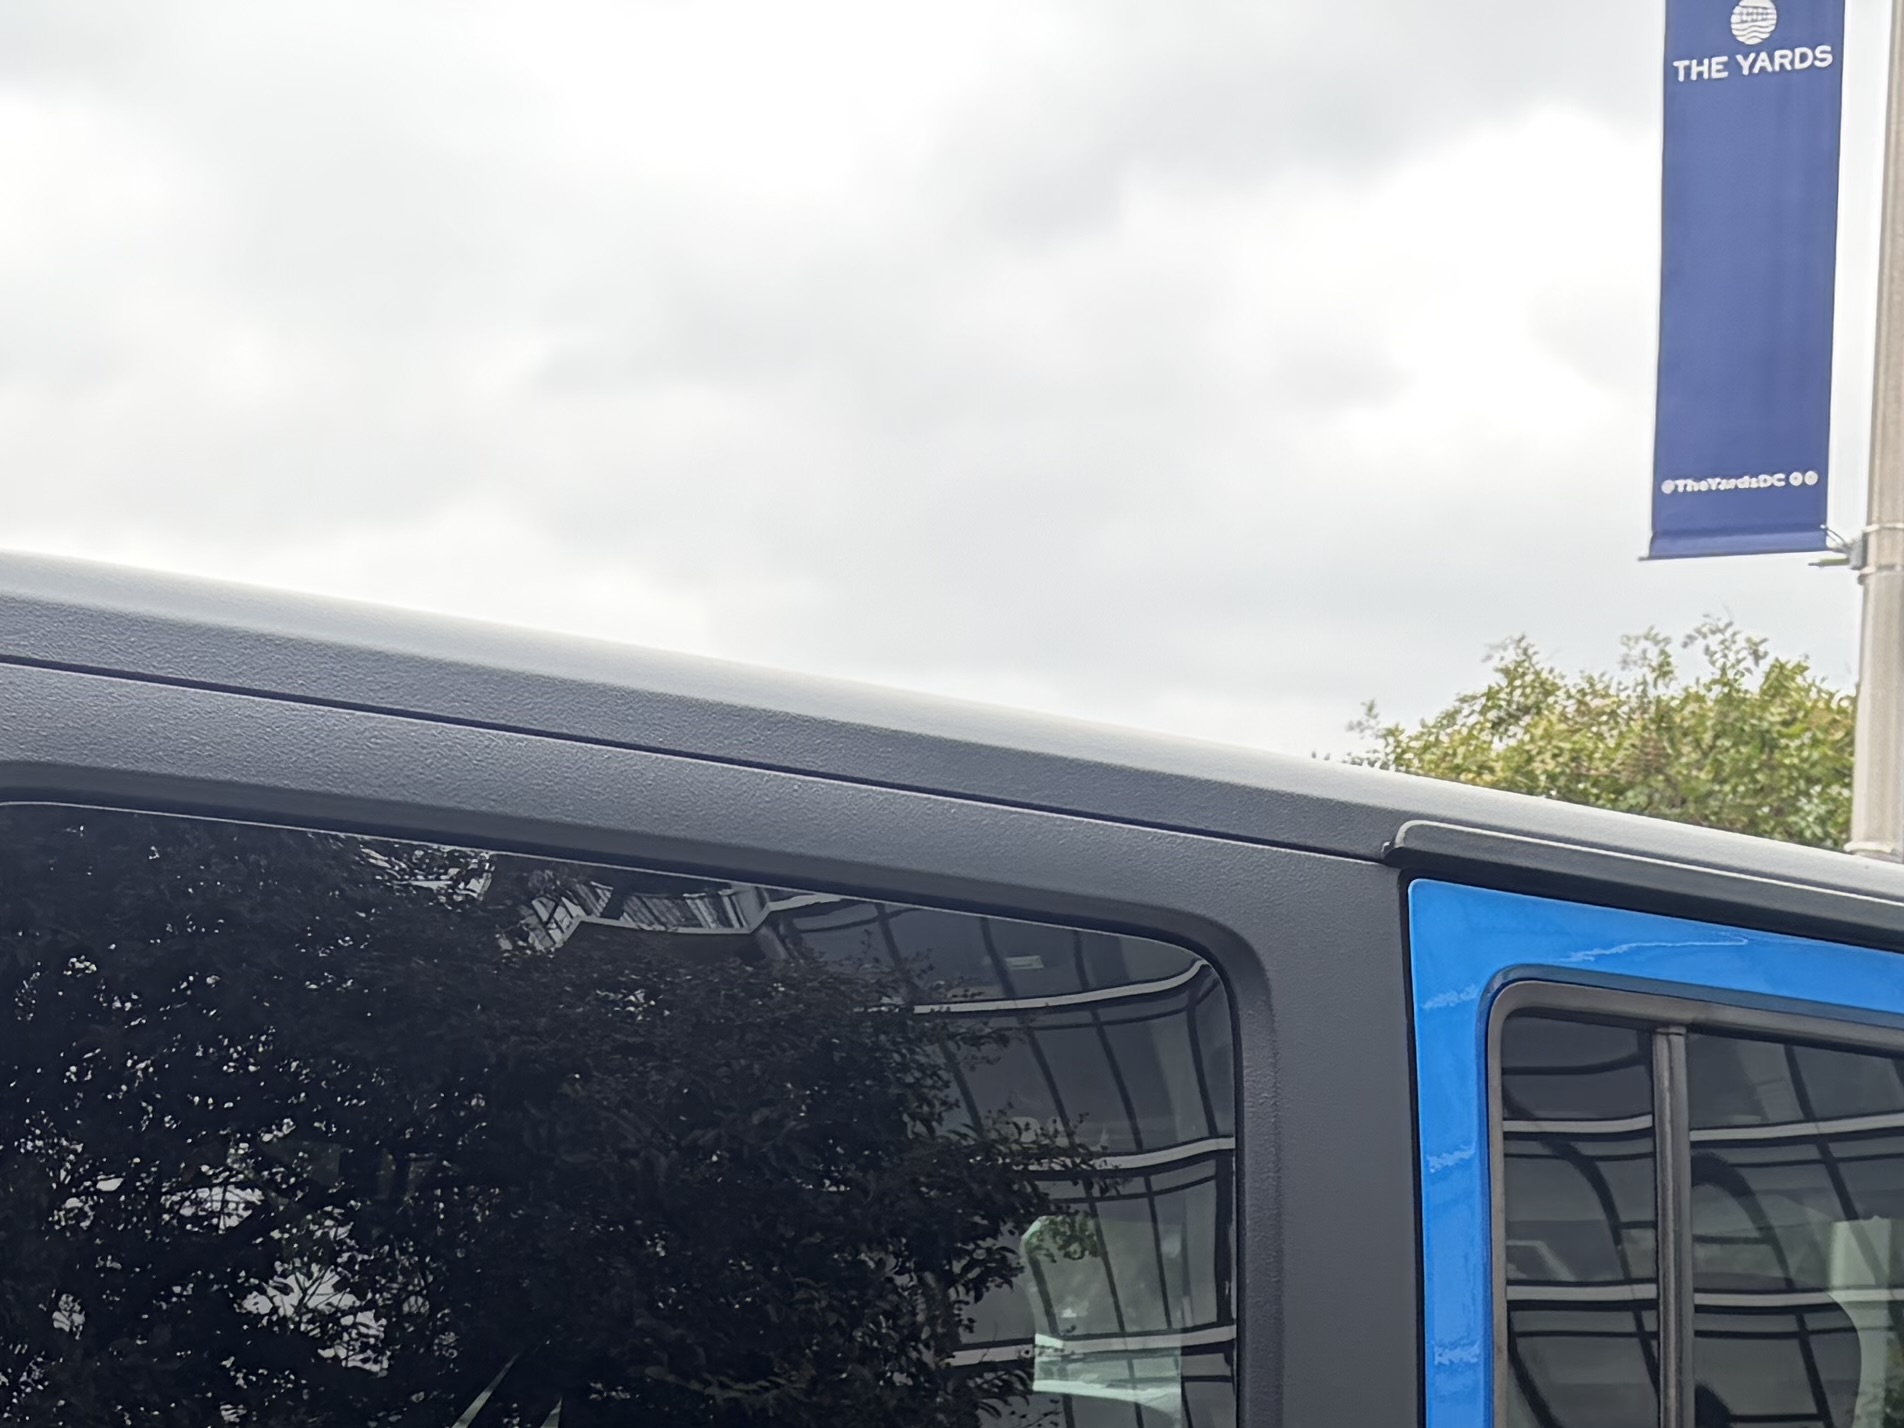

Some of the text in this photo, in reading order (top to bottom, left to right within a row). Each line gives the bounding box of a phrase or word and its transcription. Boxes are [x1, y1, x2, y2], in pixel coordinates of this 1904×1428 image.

[1673, 45, 1833, 82] THE YARDS
[1661, 473, 1786, 494] @TheYardsDC
